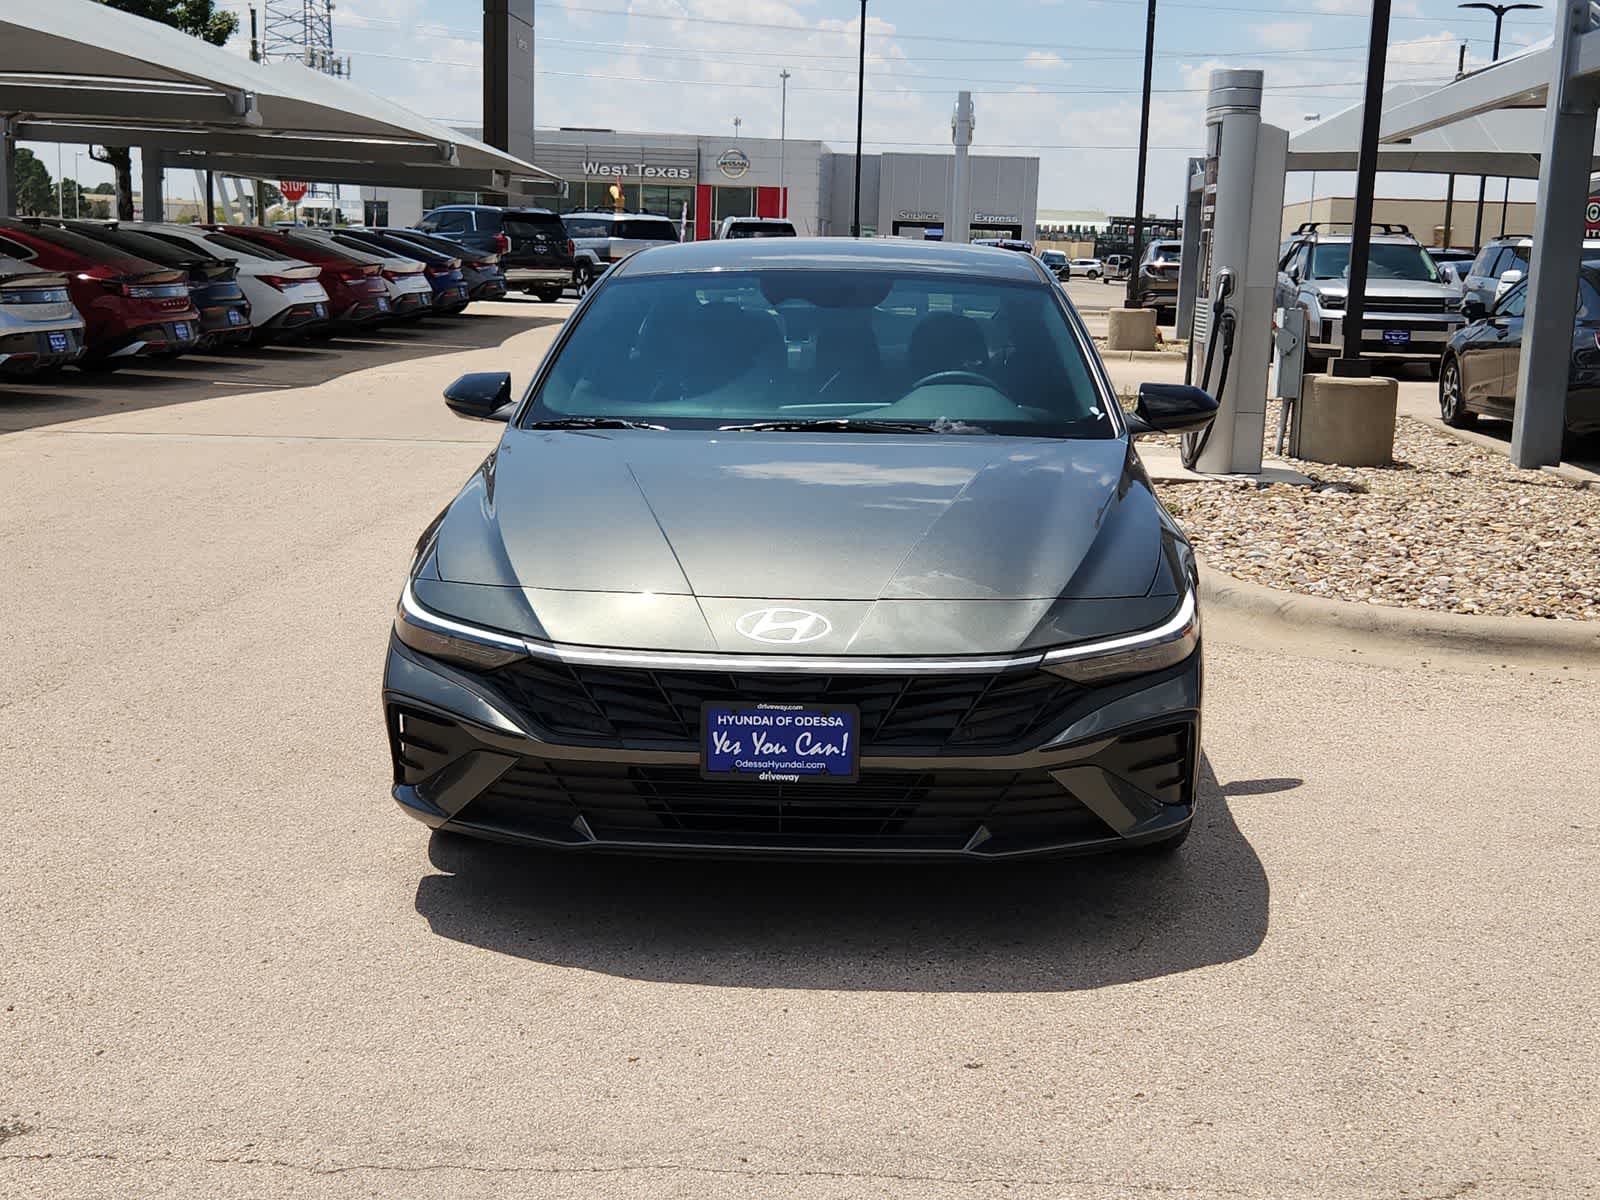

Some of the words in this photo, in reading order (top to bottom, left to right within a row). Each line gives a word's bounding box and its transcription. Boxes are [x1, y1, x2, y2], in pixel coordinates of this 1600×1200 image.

[583, 161, 629, 177] West
[634, 163, 691, 179] Texas
[282, 180, 306, 192] STOP
[974, 211, 1018, 223] Express
[757, 703, 803, 711] driveway.com
[717, 715, 773, 726] HYUNDAI
[776, 716, 793, 726] OF
[794, 716, 844, 727] ODESSA
[712, 731, 742, 755] Yes
[751, 731, 788, 756] You
[795, 732, 849, 756] Can!
[735, 759, 826, 770] OdessaHyundai.com
[759, 771, 800, 783] driveway
